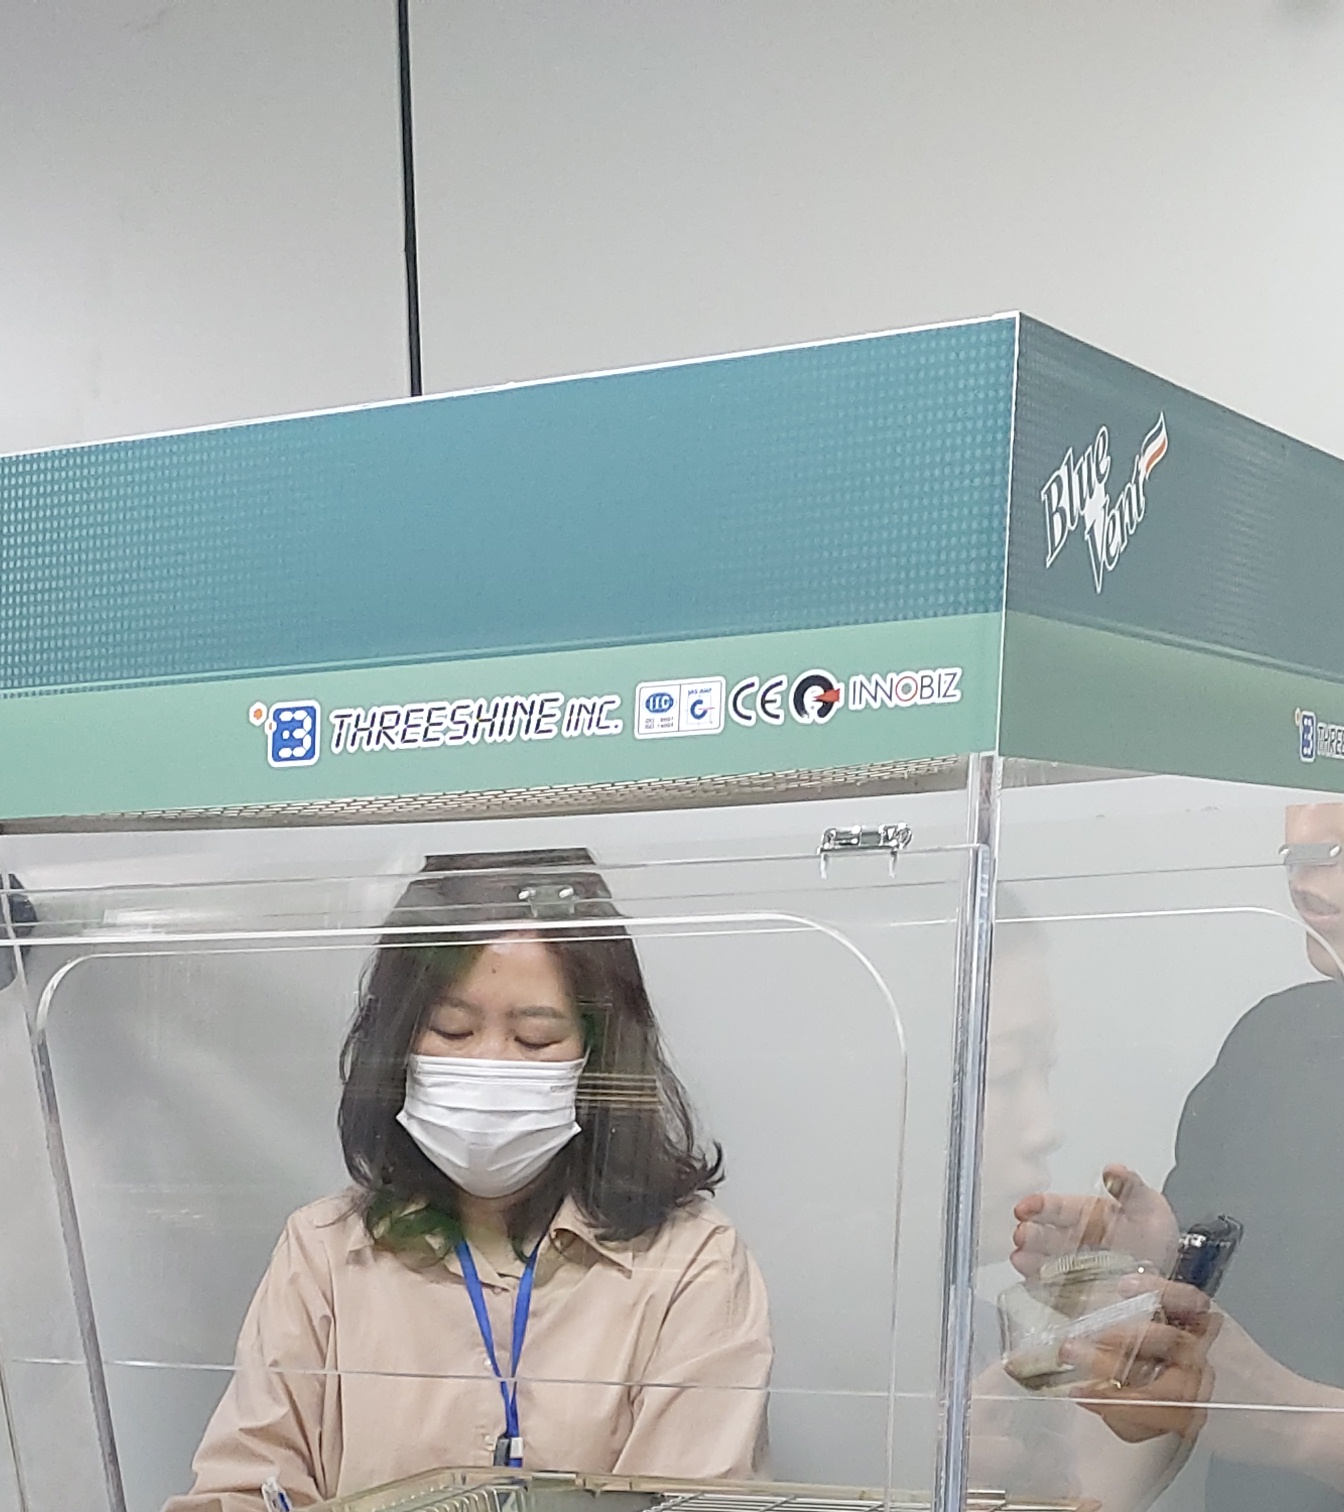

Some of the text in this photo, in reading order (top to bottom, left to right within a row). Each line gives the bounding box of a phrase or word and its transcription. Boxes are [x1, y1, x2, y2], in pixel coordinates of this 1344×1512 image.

[1041, 425, 1111, 569] Blue
[732, 680, 784, 721] CE
[852, 671, 959, 706] INNOBIZ
[333, 697, 560, 749] THREESHINE
[565, 700, 619, 733] INC.
